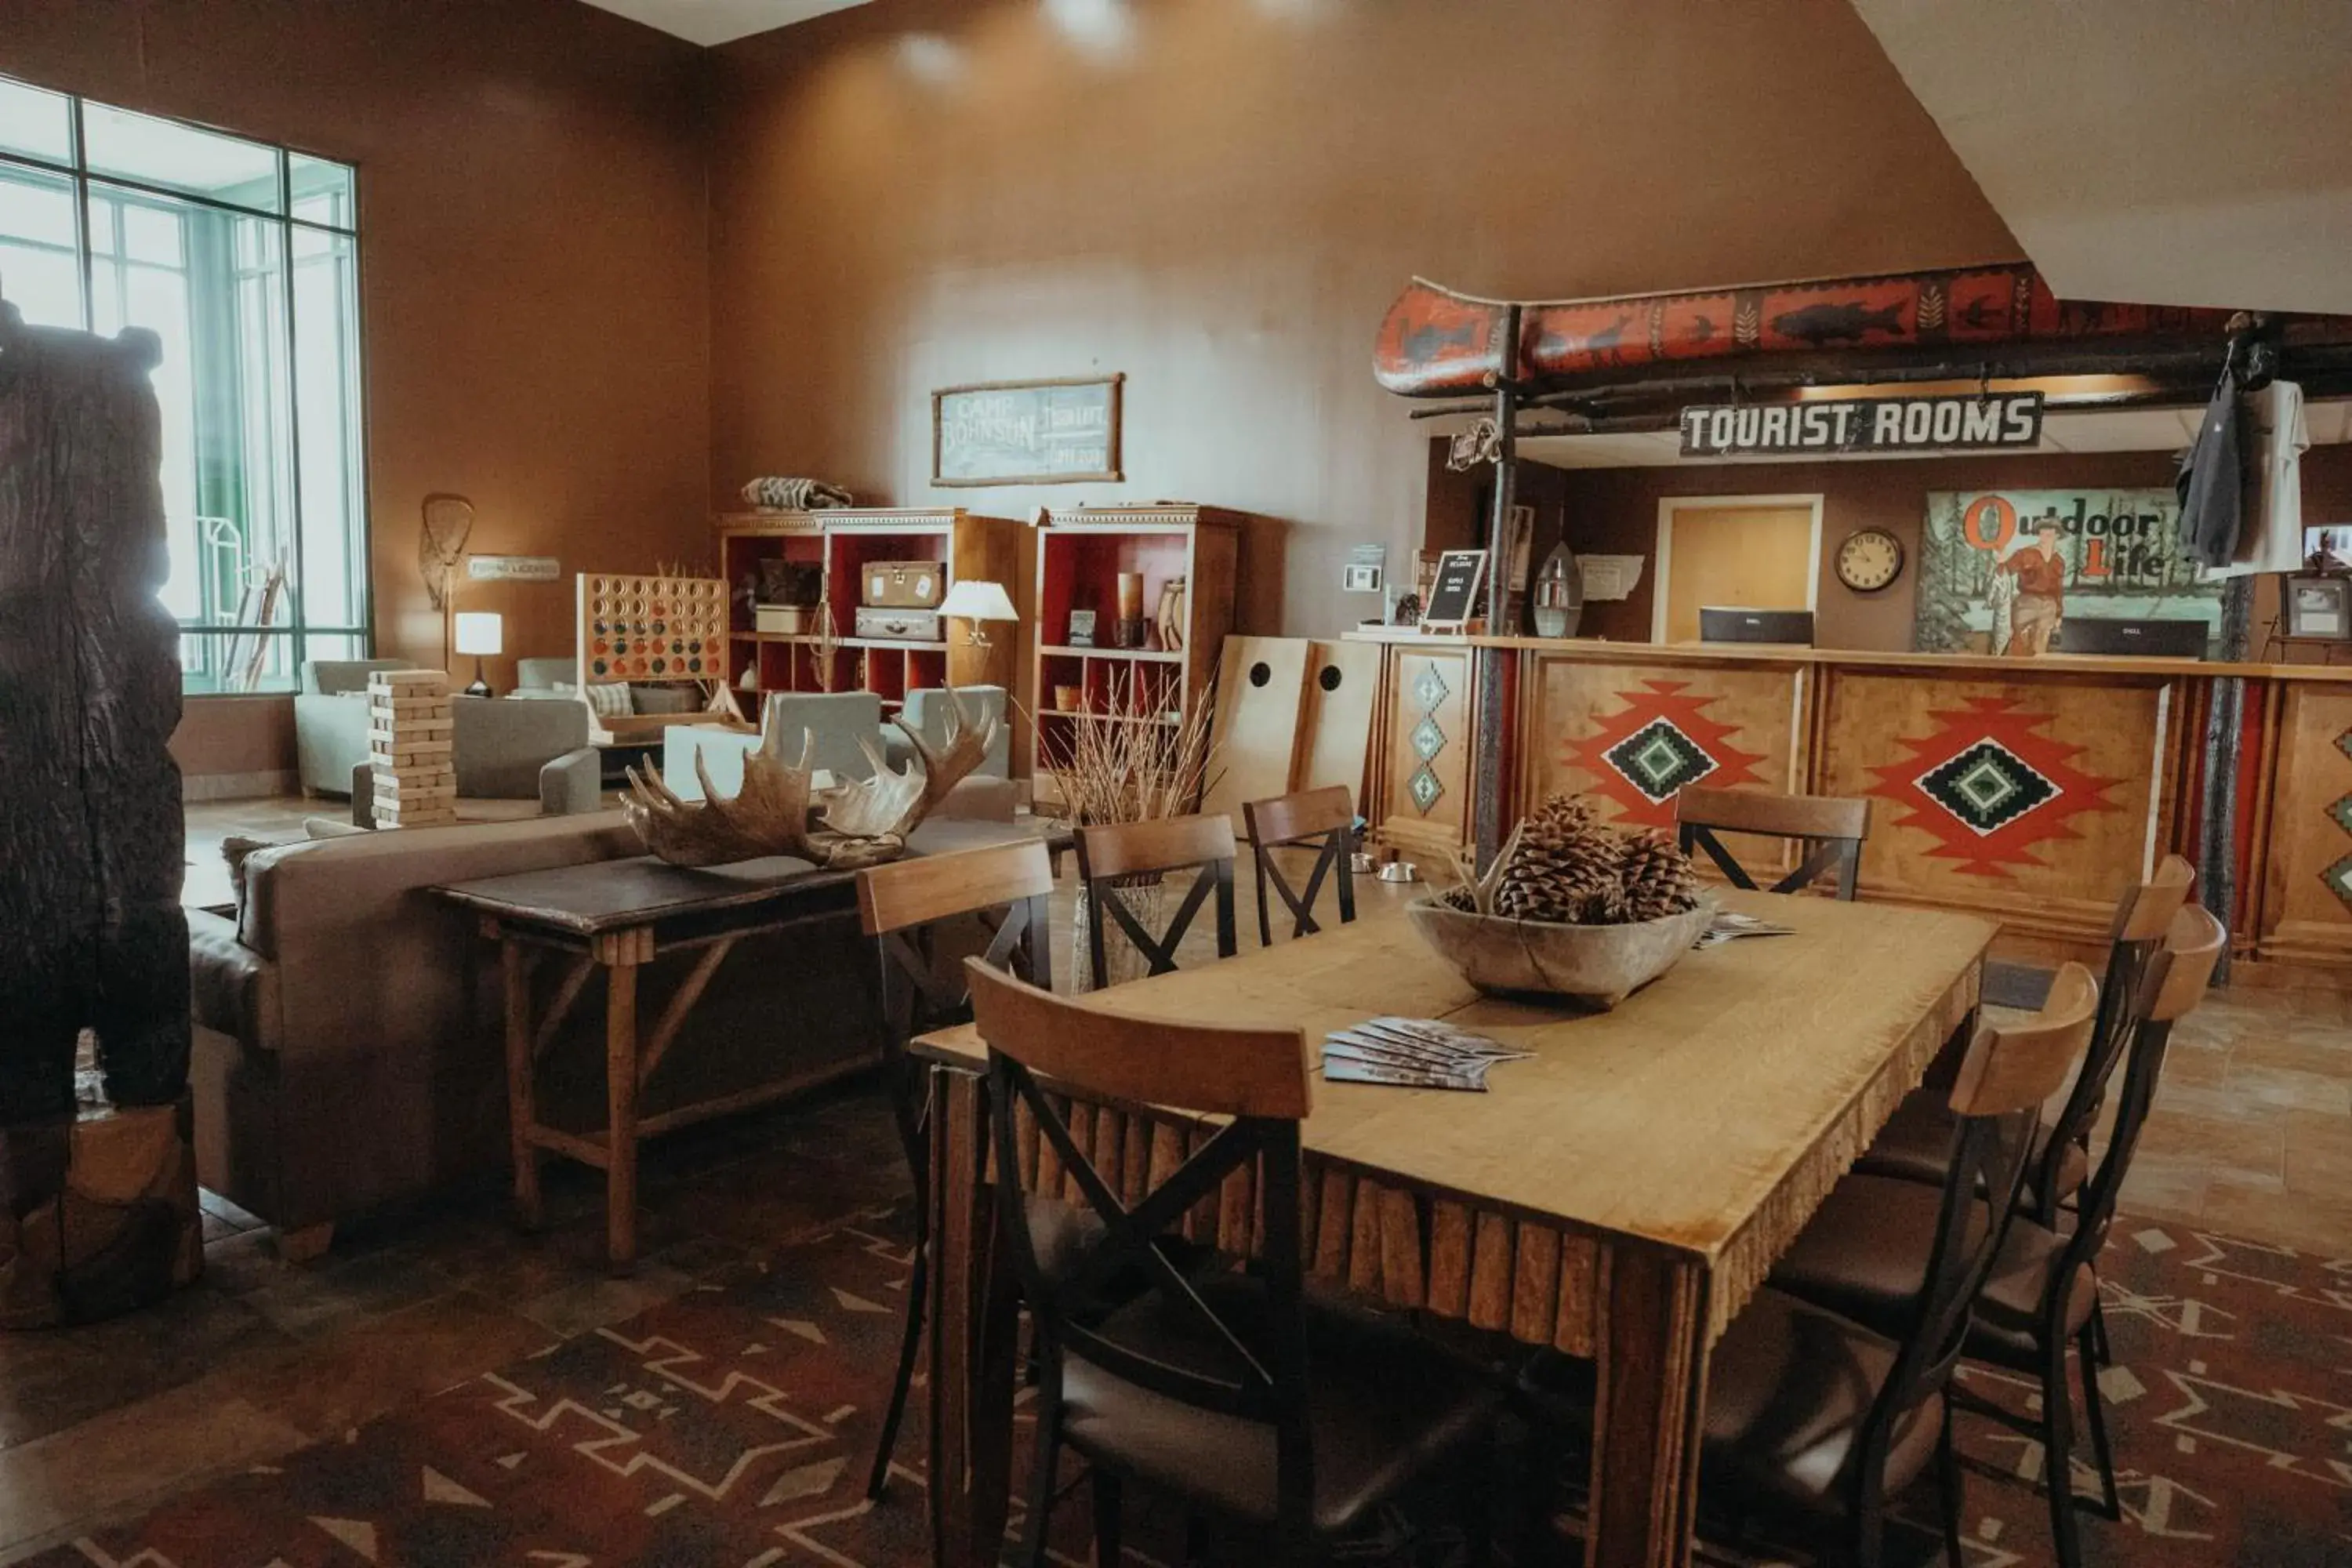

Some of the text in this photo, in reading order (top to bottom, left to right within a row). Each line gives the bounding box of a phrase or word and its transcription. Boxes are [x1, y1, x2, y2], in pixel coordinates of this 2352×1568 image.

[957, 397, 1014, 419] CAMP
[1686, 397, 2036, 448] TOURIST ROOMS
[2082, 539, 2165, 576] Life
